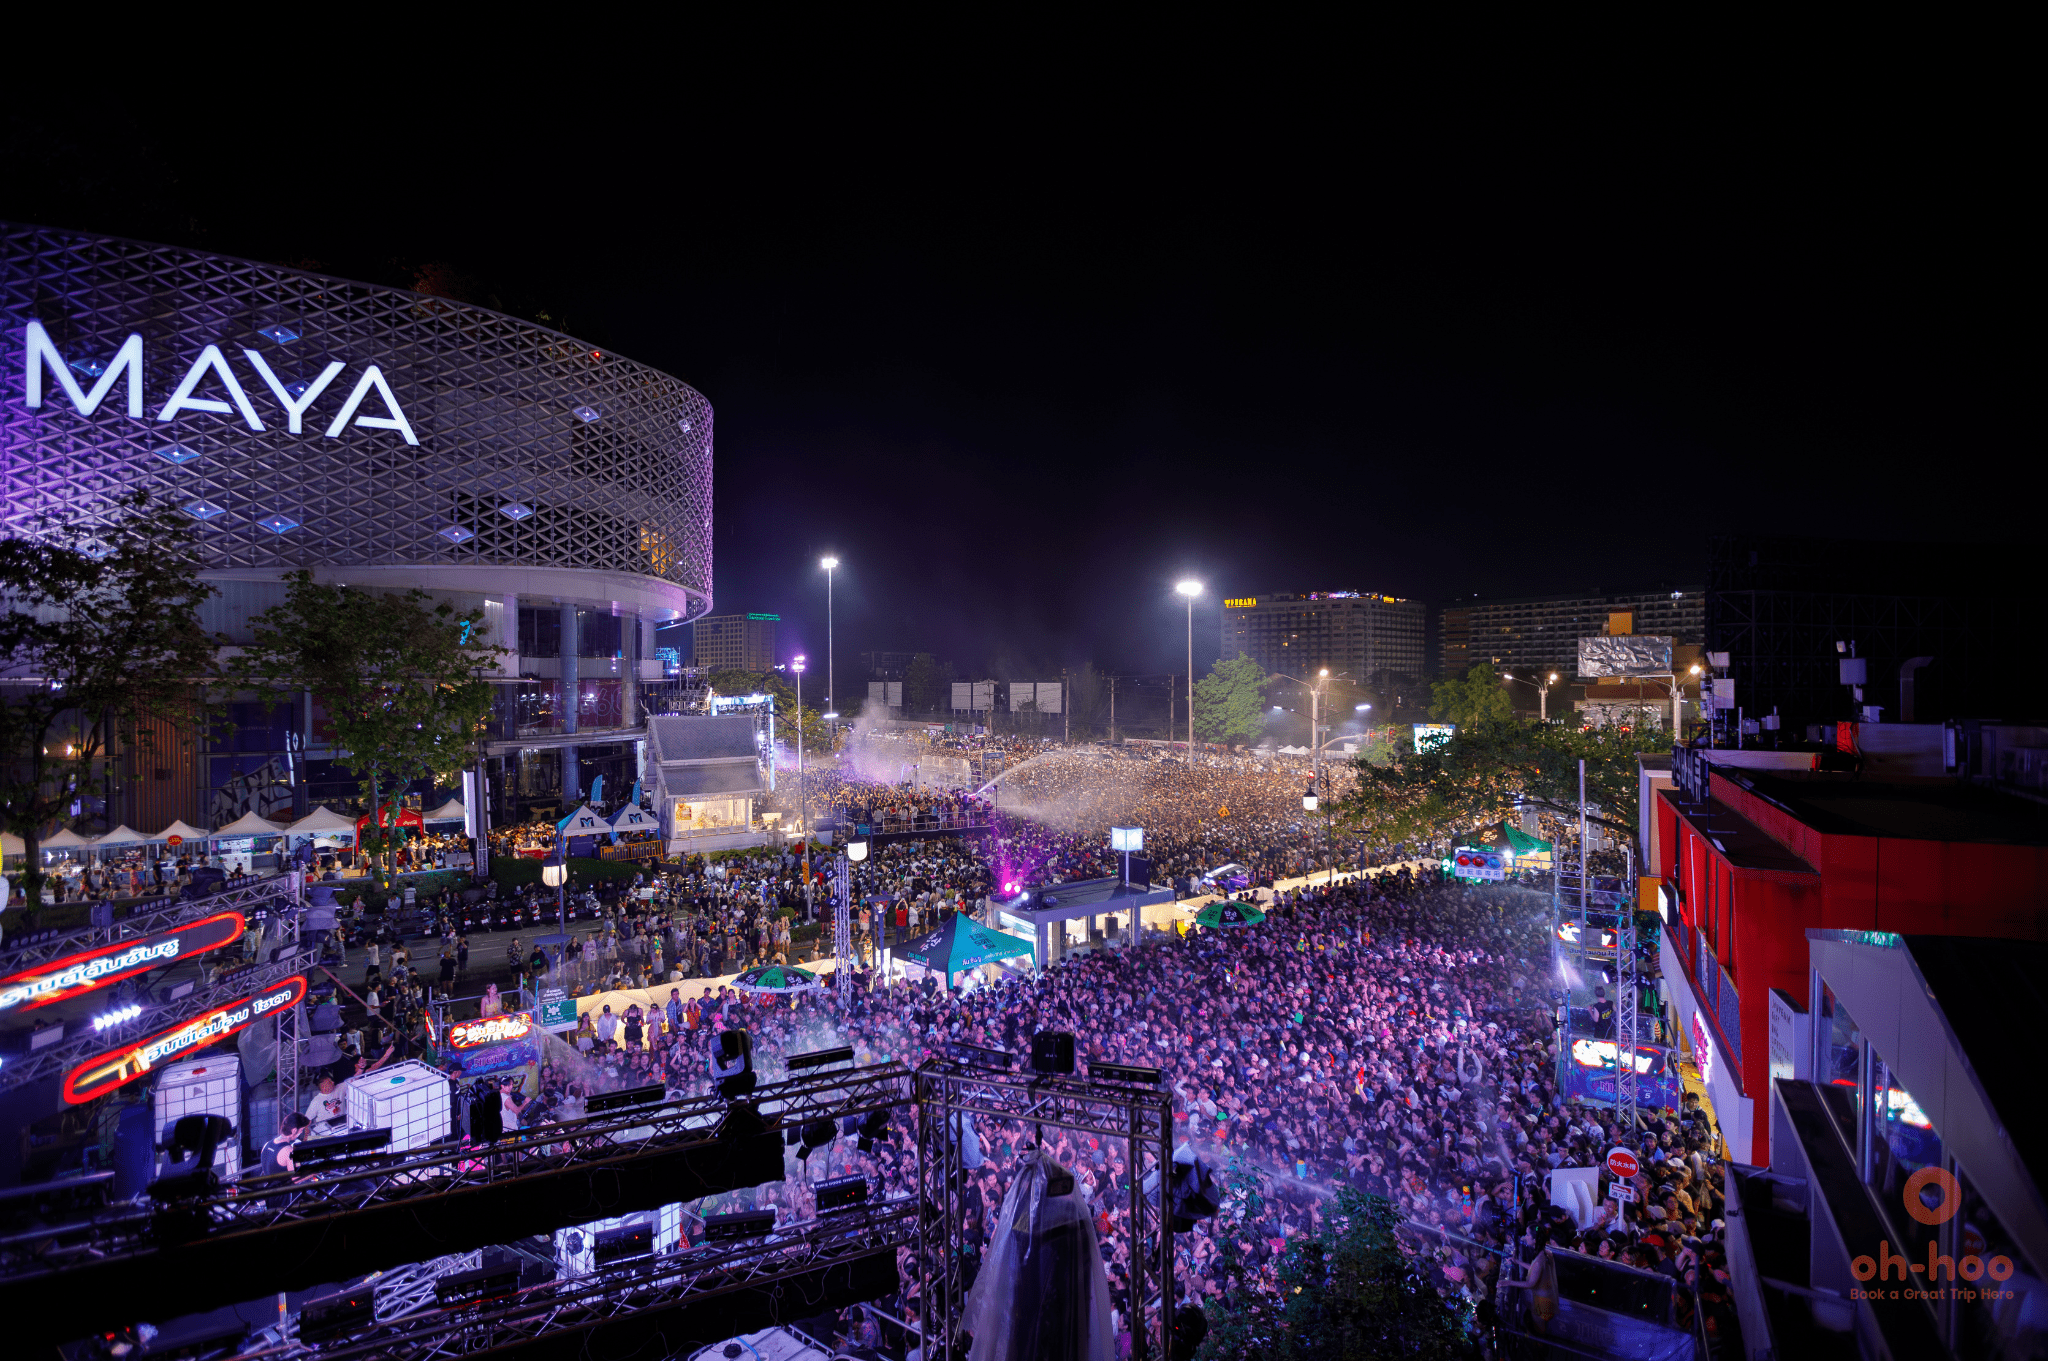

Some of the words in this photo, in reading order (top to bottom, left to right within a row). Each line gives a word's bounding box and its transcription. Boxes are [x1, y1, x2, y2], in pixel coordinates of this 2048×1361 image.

[25, 317, 420, 447] MAYA
[252, 989, 292, 1014] โซดา
[1609, 1158, 1637, 1171] 防火水槽
